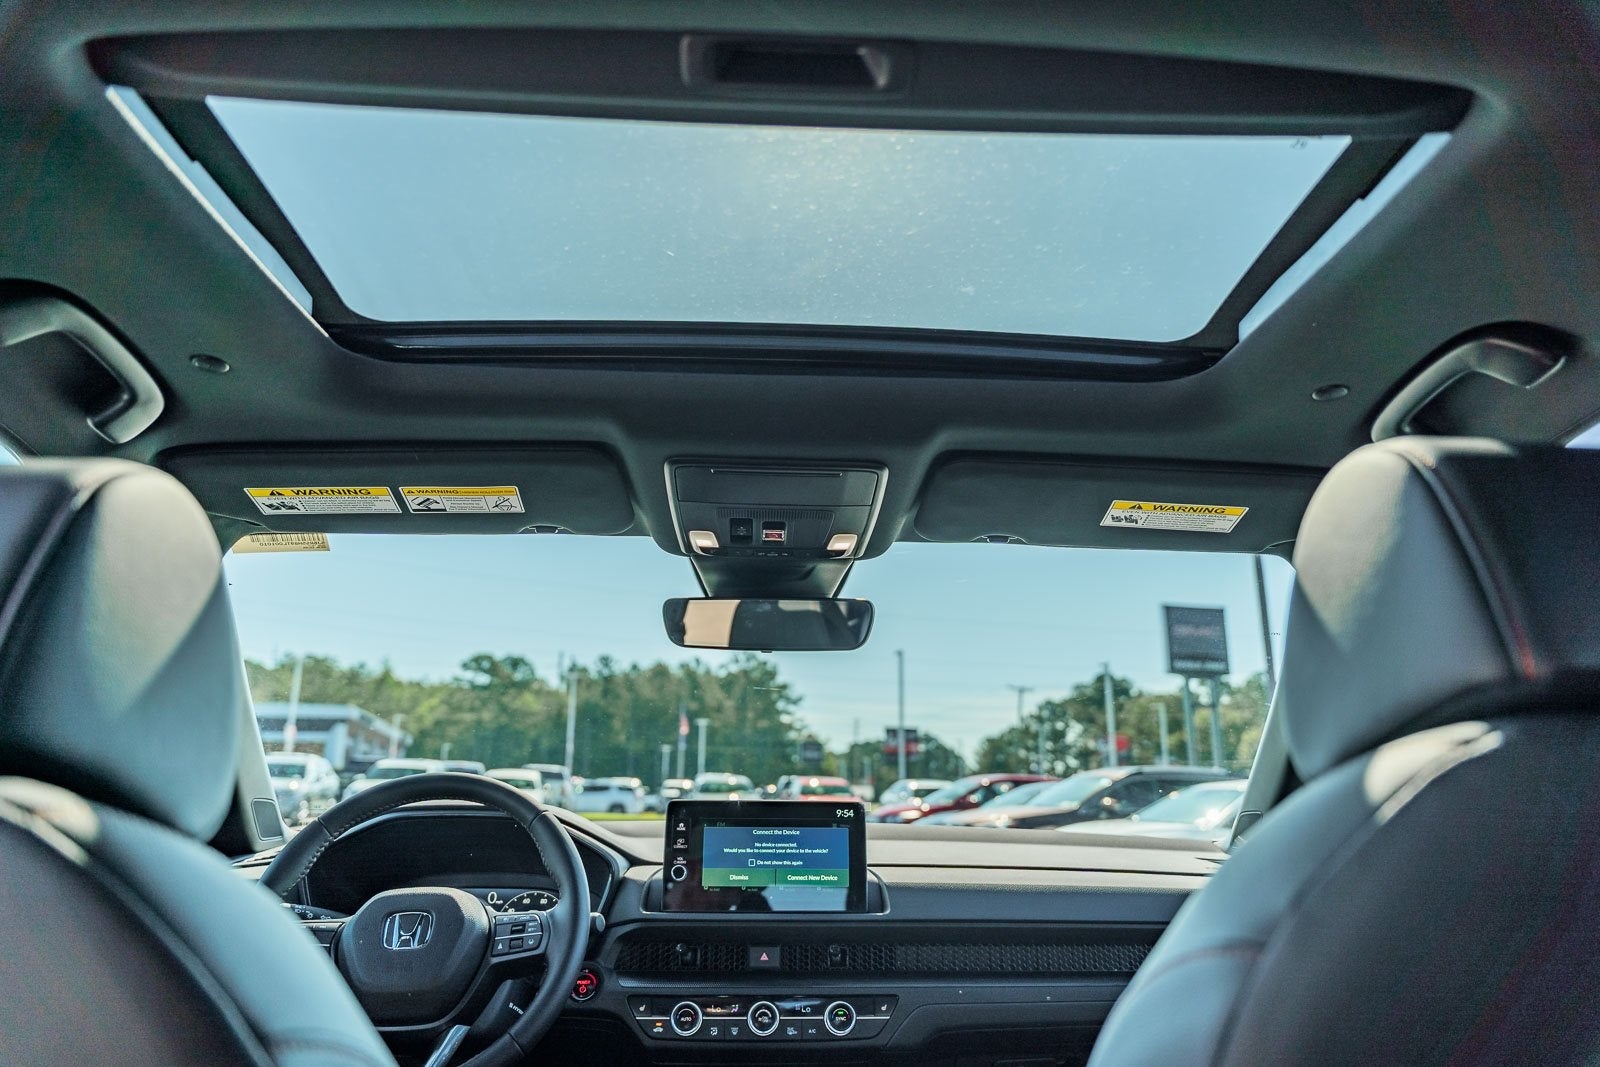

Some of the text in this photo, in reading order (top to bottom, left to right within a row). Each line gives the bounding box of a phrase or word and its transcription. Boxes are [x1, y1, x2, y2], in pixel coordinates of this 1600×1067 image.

[290, 488, 371, 496] WARNING
[1153, 504, 1226, 513] WARNING
[836, 809, 854, 818] 9:54
[487, 891, 498, 905] 0
